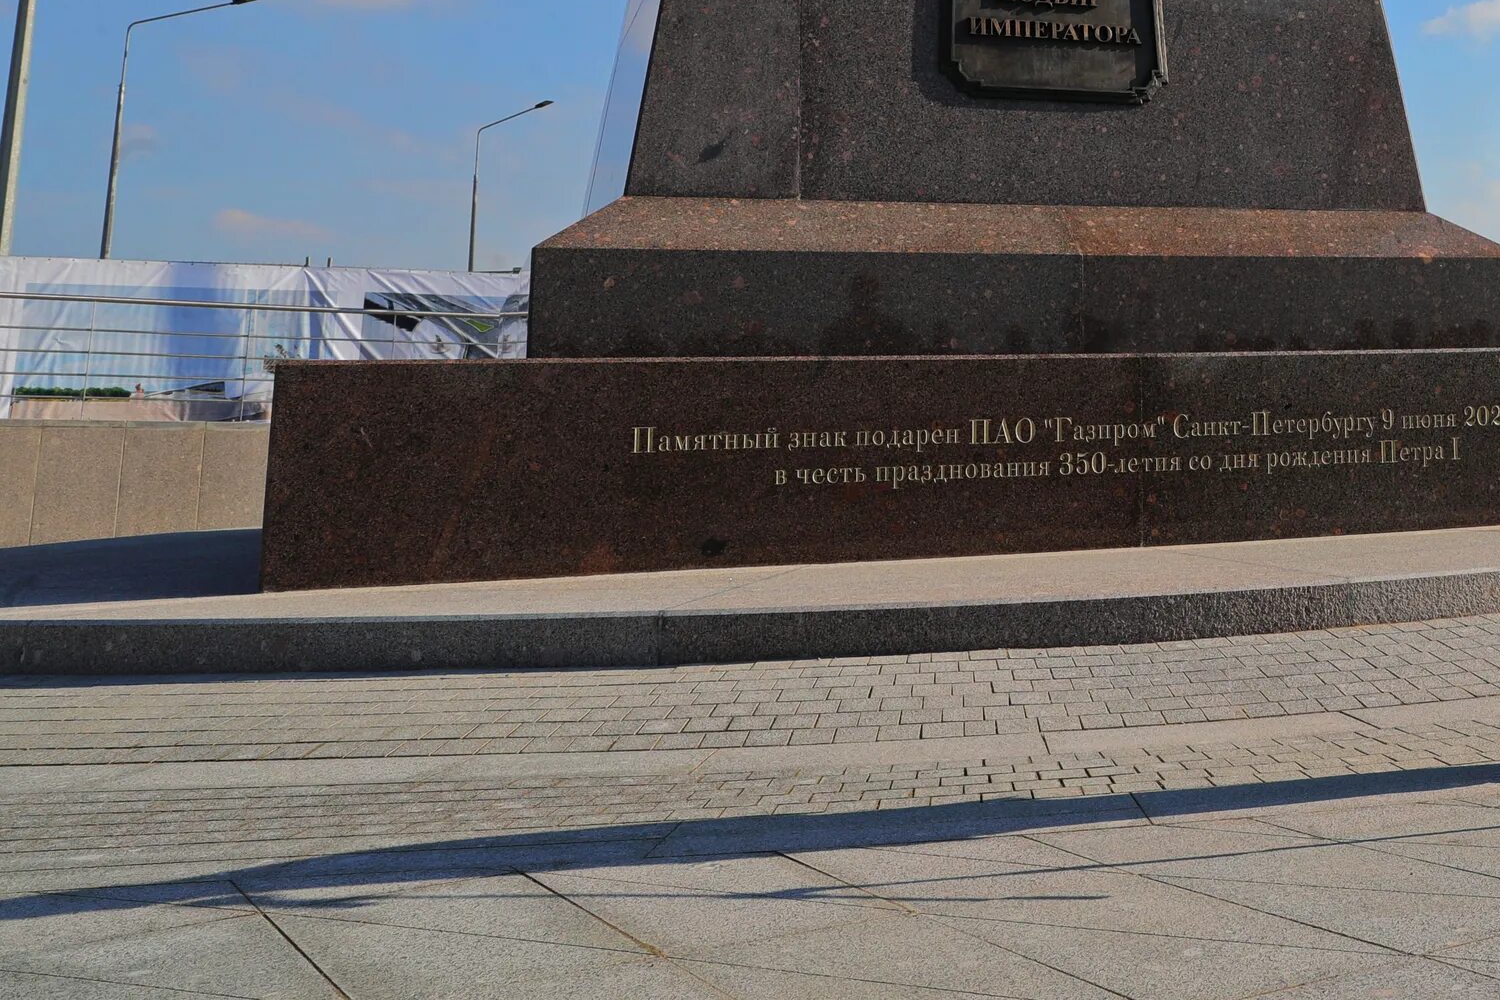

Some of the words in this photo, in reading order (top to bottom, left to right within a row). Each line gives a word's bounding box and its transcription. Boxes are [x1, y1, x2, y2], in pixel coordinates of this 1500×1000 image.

[968, 16, 1142, 44] ИМПЕРАТОРА
[630, 427, 781, 454] Памятный
[787, 430, 848, 450] знак
[855, 428, 961, 452] подарен
[968, 417, 1037, 446] ПАО
[1044, 414, 1166, 447] "Газпром"
[1173, 410, 1377, 440] Санкт-Петербургу
[1381, 408, 1395, 430] 9
[1402, 412, 1458, 430] июня
[774, 468, 788, 486] в
[796, 465, 867, 484] честь
[876, 458, 1052, 489] празднования
[1059, 451, 1183, 476] 350-летия
[1188, 454, 1212, 472] со
[1219, 453, 1262, 473] дня
[1266, 447, 1371, 475] рождения
[1379, 439, 1445, 468] Петра
[1451, 437, 1462, 461] I
